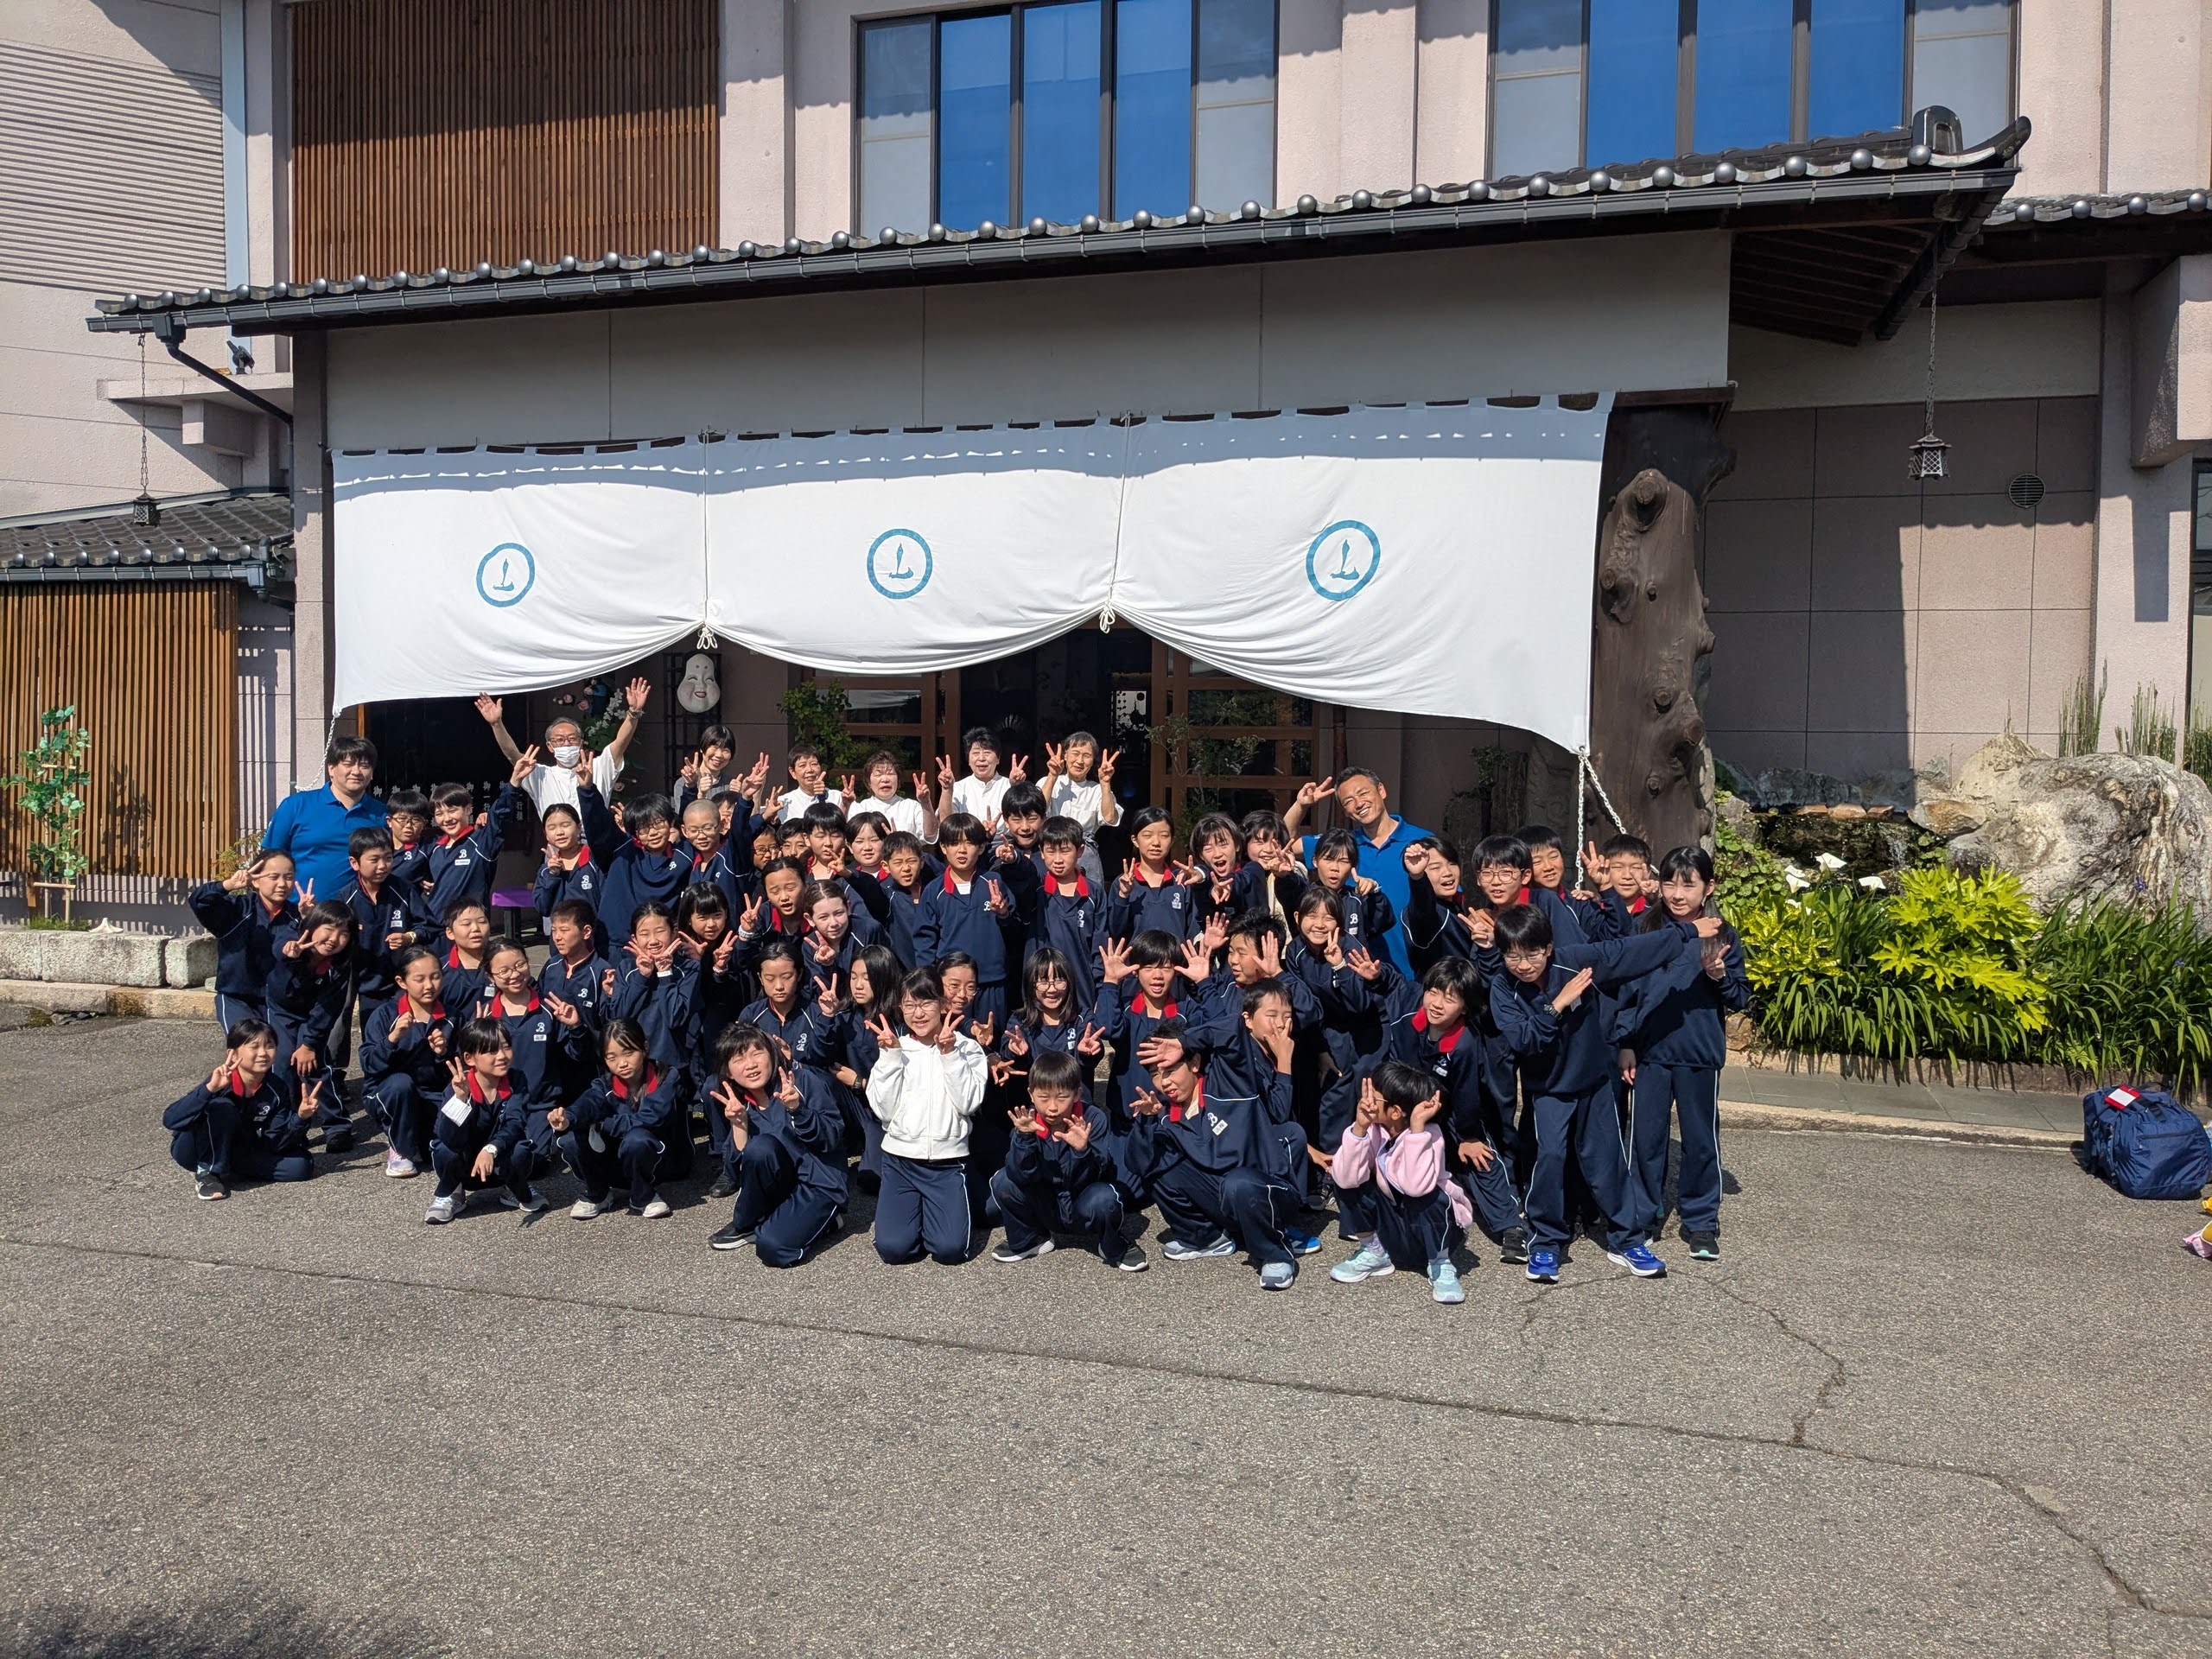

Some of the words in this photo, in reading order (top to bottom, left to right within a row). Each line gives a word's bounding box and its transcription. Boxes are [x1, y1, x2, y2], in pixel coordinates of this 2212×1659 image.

[404, 851, 413, 861] B
[459, 849, 467, 859] B
[581, 874, 590, 884] B
[391, 909, 402, 920] B
[1350, 912, 1359, 925] B
[577, 988, 588, 998] B
[536, 1021, 546, 1033] B
[798, 1033, 808, 1044] B
[1066, 1027, 1077, 1040] B
[1206, 1111, 1218, 1127] B
